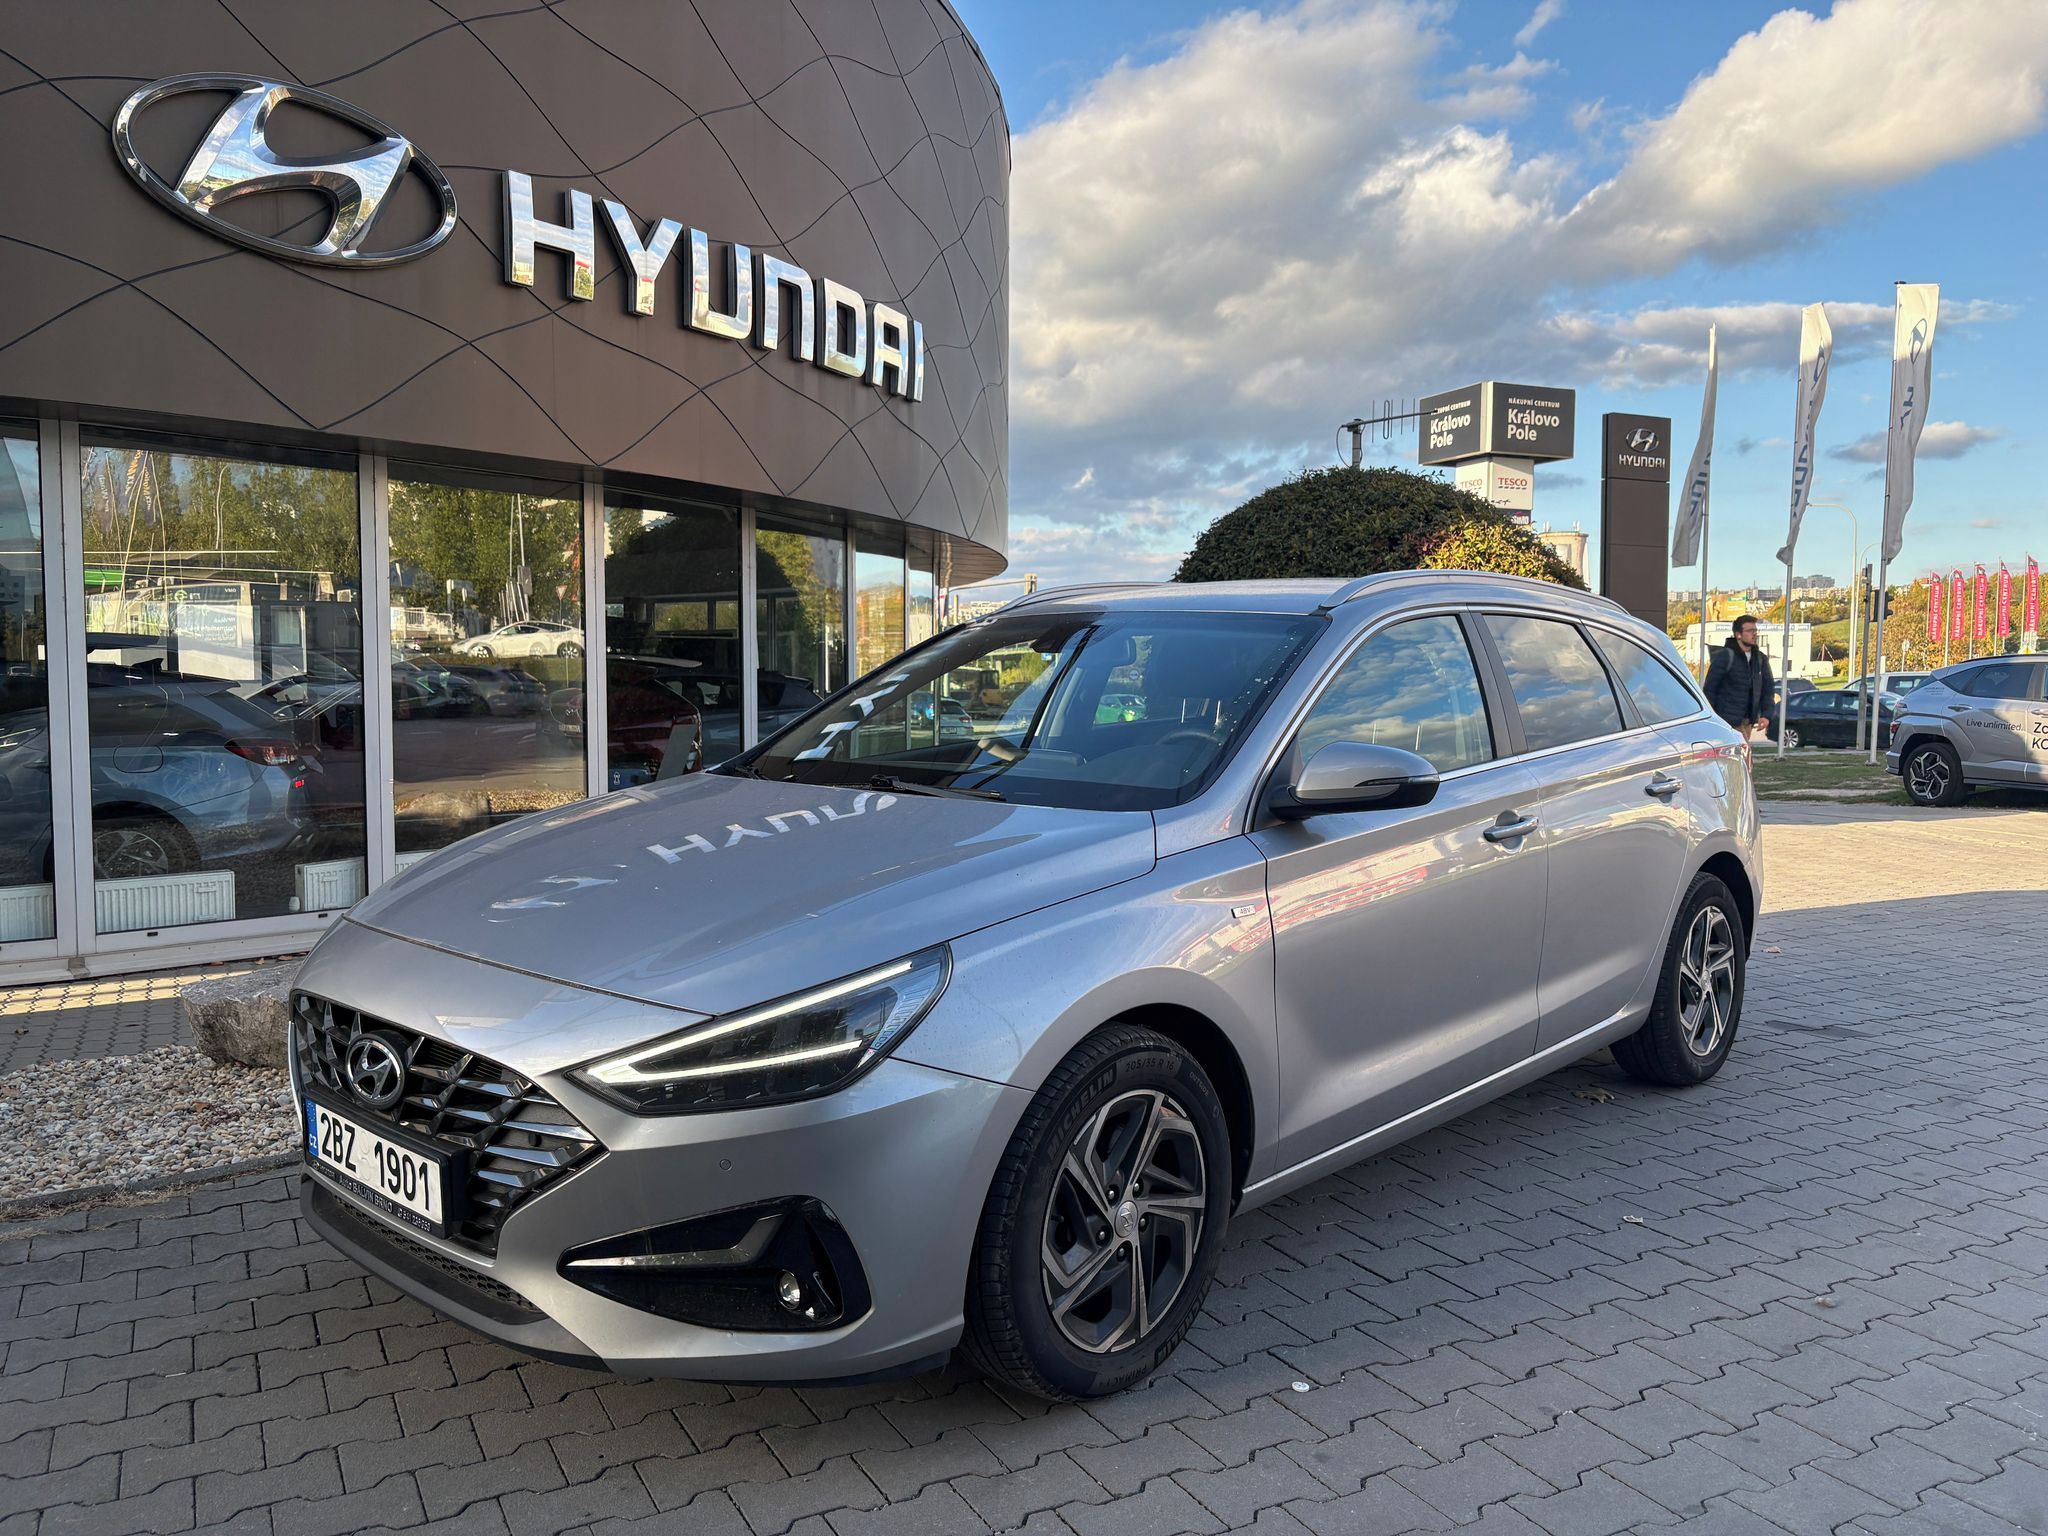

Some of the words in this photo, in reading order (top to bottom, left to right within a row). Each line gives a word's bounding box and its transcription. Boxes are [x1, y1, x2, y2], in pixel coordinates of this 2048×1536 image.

[503, 168, 924, 402] HYUNDAI
[1534, 400, 1560, 408] CENTRUM
[1430, 414, 1471, 434] Královo
[1508, 408, 1560, 427] Královo
[1430, 432, 1453, 449] Pole
[1507, 425, 1537, 440] Pole
[1619, 454, 1666, 468] HYUNDAI
[1461, 479, 1483, 489] TESCO
[1498, 477, 1528, 486] TESCO
[1966, 718, 1982, 728] Live
[1047, 1068, 1114, 1159] MICHELIN
[309, 1133, 317, 1149] CZ
[320, 1112, 357, 1174] 2BZ
[374, 1140, 430, 1212] 1901
[374, 1195, 393, 1214] BRNO
